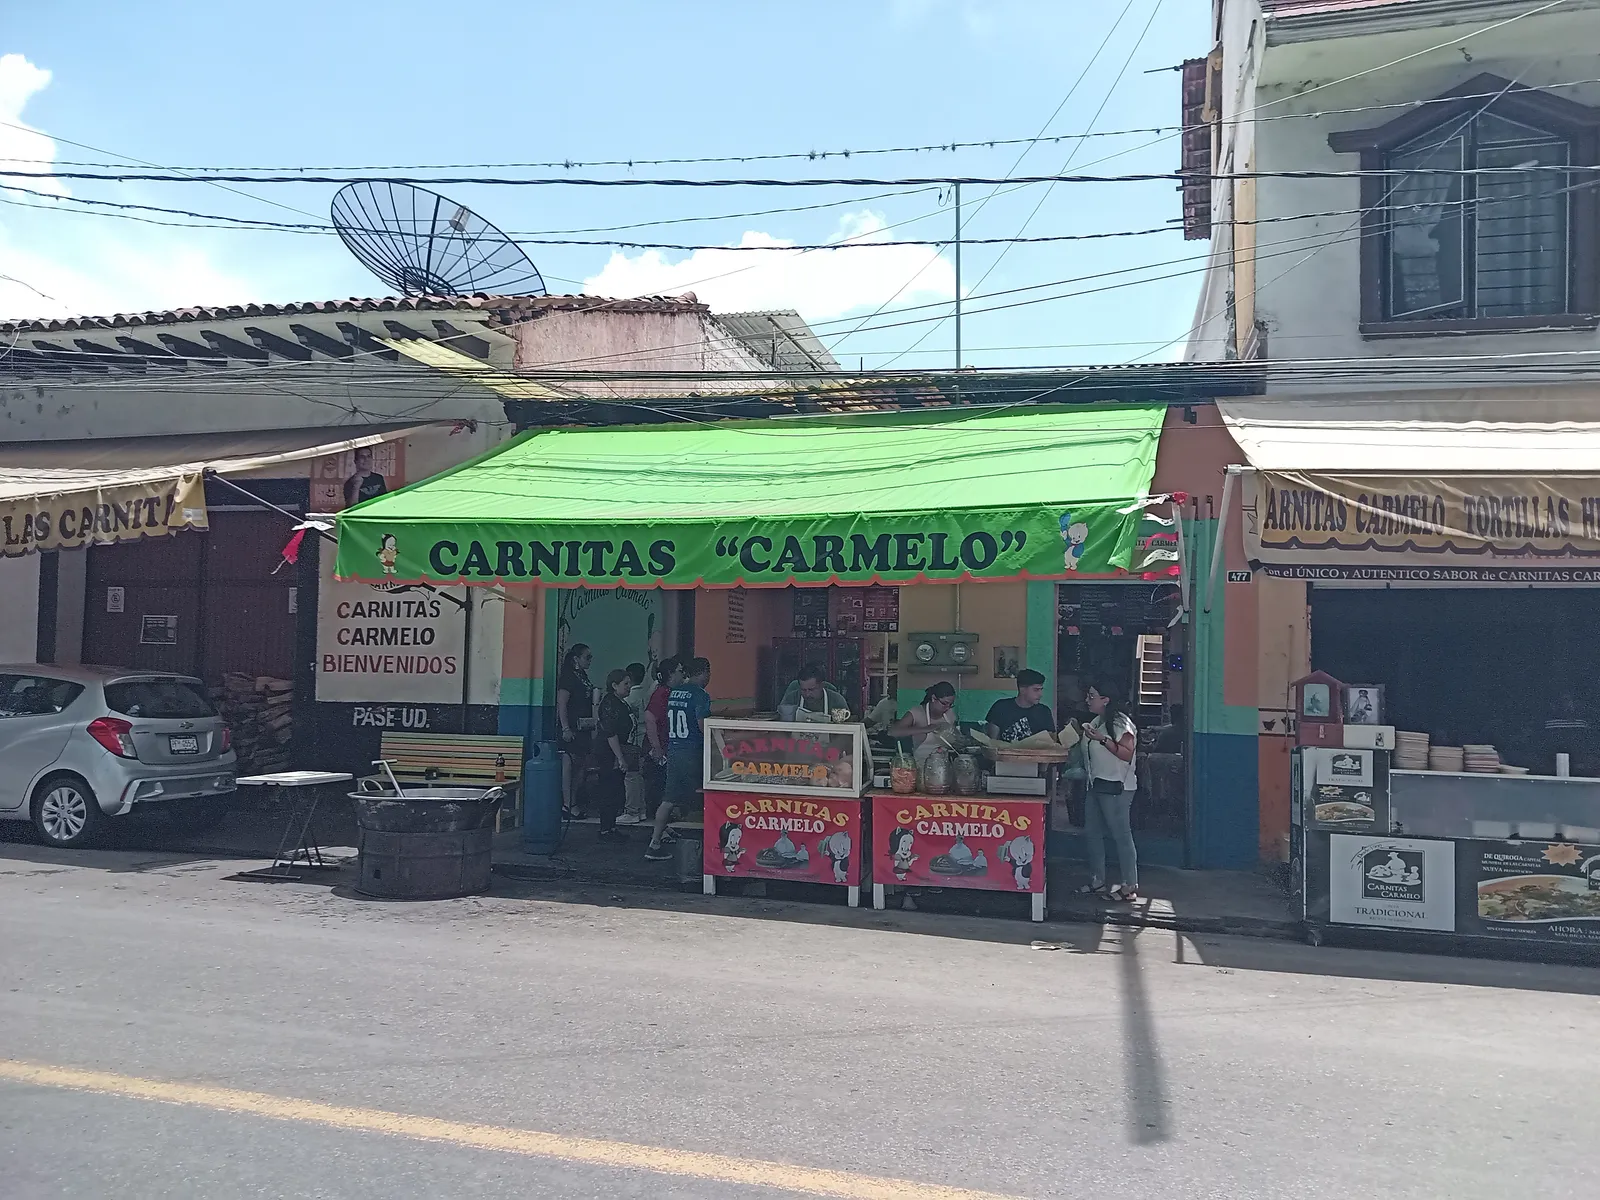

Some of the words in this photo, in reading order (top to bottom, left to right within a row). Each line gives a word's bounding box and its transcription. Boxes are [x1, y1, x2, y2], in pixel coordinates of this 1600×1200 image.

[1355, 493, 1446, 536] CARMELO
[1463, 496, 1570, 538] TORTILLAS
[429, 540, 676, 576] CARNITAS
[1231, 571, 1248, 582] 477
[1283, 568, 1293, 577] el
[1296, 566, 1339, 578] ÚNICO
[1342, 570, 1349, 579] y
[1352, 568, 1430, 579] AUTENTICO
[1433, 570, 1479, 581] SABOR
[1482, 570, 1496, 580] de
[1499, 571, 1570, 581] CARNITAS
[336, 600, 441, 619] CARNITAS
[336, 627, 436, 646] CARMELO
[322, 654, 457, 675] BIENVENIDOS
[667, 709, 689, 739] 10
[722, 737, 840, 761] CARNITAS
[731, 761, 828, 779] CARMELO
[725, 798, 850, 828] CARNITAS
[895, 802, 1032, 832] CARNITAS
[744, 815, 826, 834] CARMELO
[916, 820, 1006, 839] CARMELO
[1367, 883, 1408, 892] CARNITAS
[1380, 890, 1421, 900] CARMELO
[1355, 906, 1427, 919] TRADICIONAL
